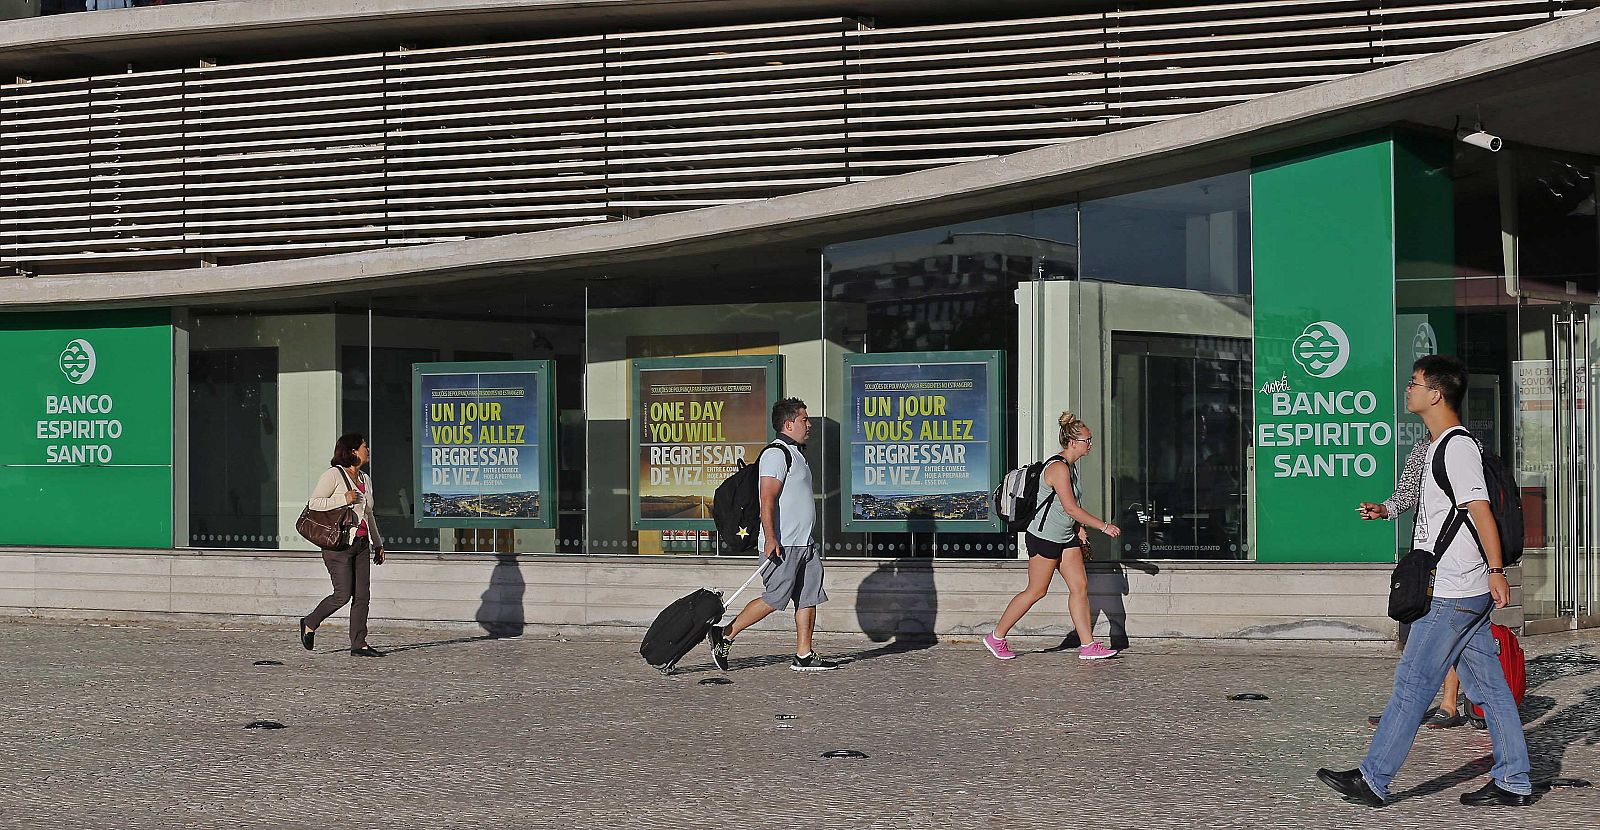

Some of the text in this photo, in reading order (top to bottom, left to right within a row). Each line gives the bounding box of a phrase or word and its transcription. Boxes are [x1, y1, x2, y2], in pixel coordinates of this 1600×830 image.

[46, 394, 112, 414] BANCO
[650, 402, 684, 422] ONE
[690, 401, 724, 420] DAY
[864, 396, 891, 416] UN
[898, 396, 946, 420] JOUR
[1272, 390, 1376, 416] BANCO
[432, 403, 454, 422] UN
[460, 402, 502, 425] JOUR
[36, 420, 122, 438] ESPIRITO
[431, 425, 525, 444] VOUS ALLEZ
[649, 422, 726, 442] YOU WILL
[864, 420, 974, 441] VOUS ALLEZ
[1258, 422, 1392, 446] ESPIRITO
[46, 444, 112, 463] SANTO
[432, 448, 519, 466] REGRESSAR
[650, 446, 746, 465] REGRESSAR
[864, 444, 966, 464] REGRESSAR
[1274, 453, 1376, 478] SANTO
[432, 468, 451, 485] DE
[650, 467, 670, 486] DE
[865, 466, 923, 486] DE VEZ.
